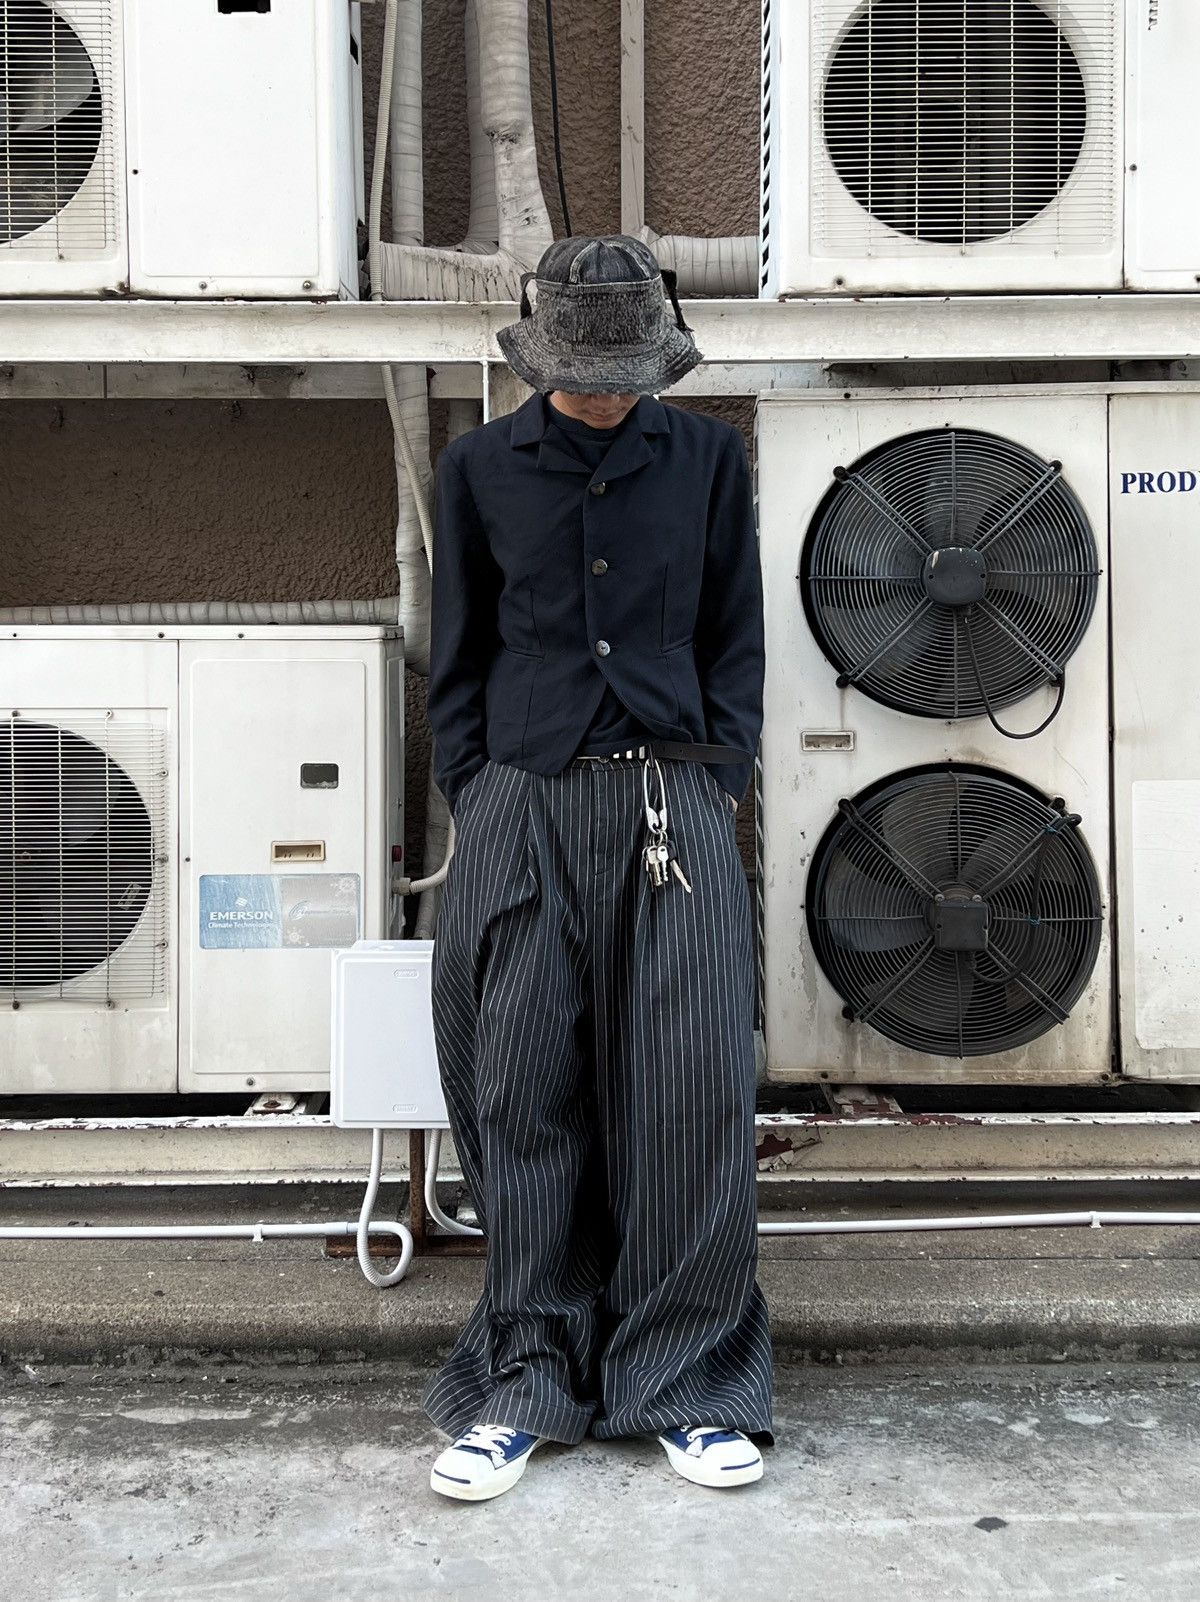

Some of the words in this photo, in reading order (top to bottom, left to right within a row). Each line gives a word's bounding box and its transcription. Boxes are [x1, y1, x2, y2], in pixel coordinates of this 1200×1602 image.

[1120, 470, 1200, 494] PROD
[209, 911, 273, 921] EMERSON
[208, 921, 233, 929] Climate
